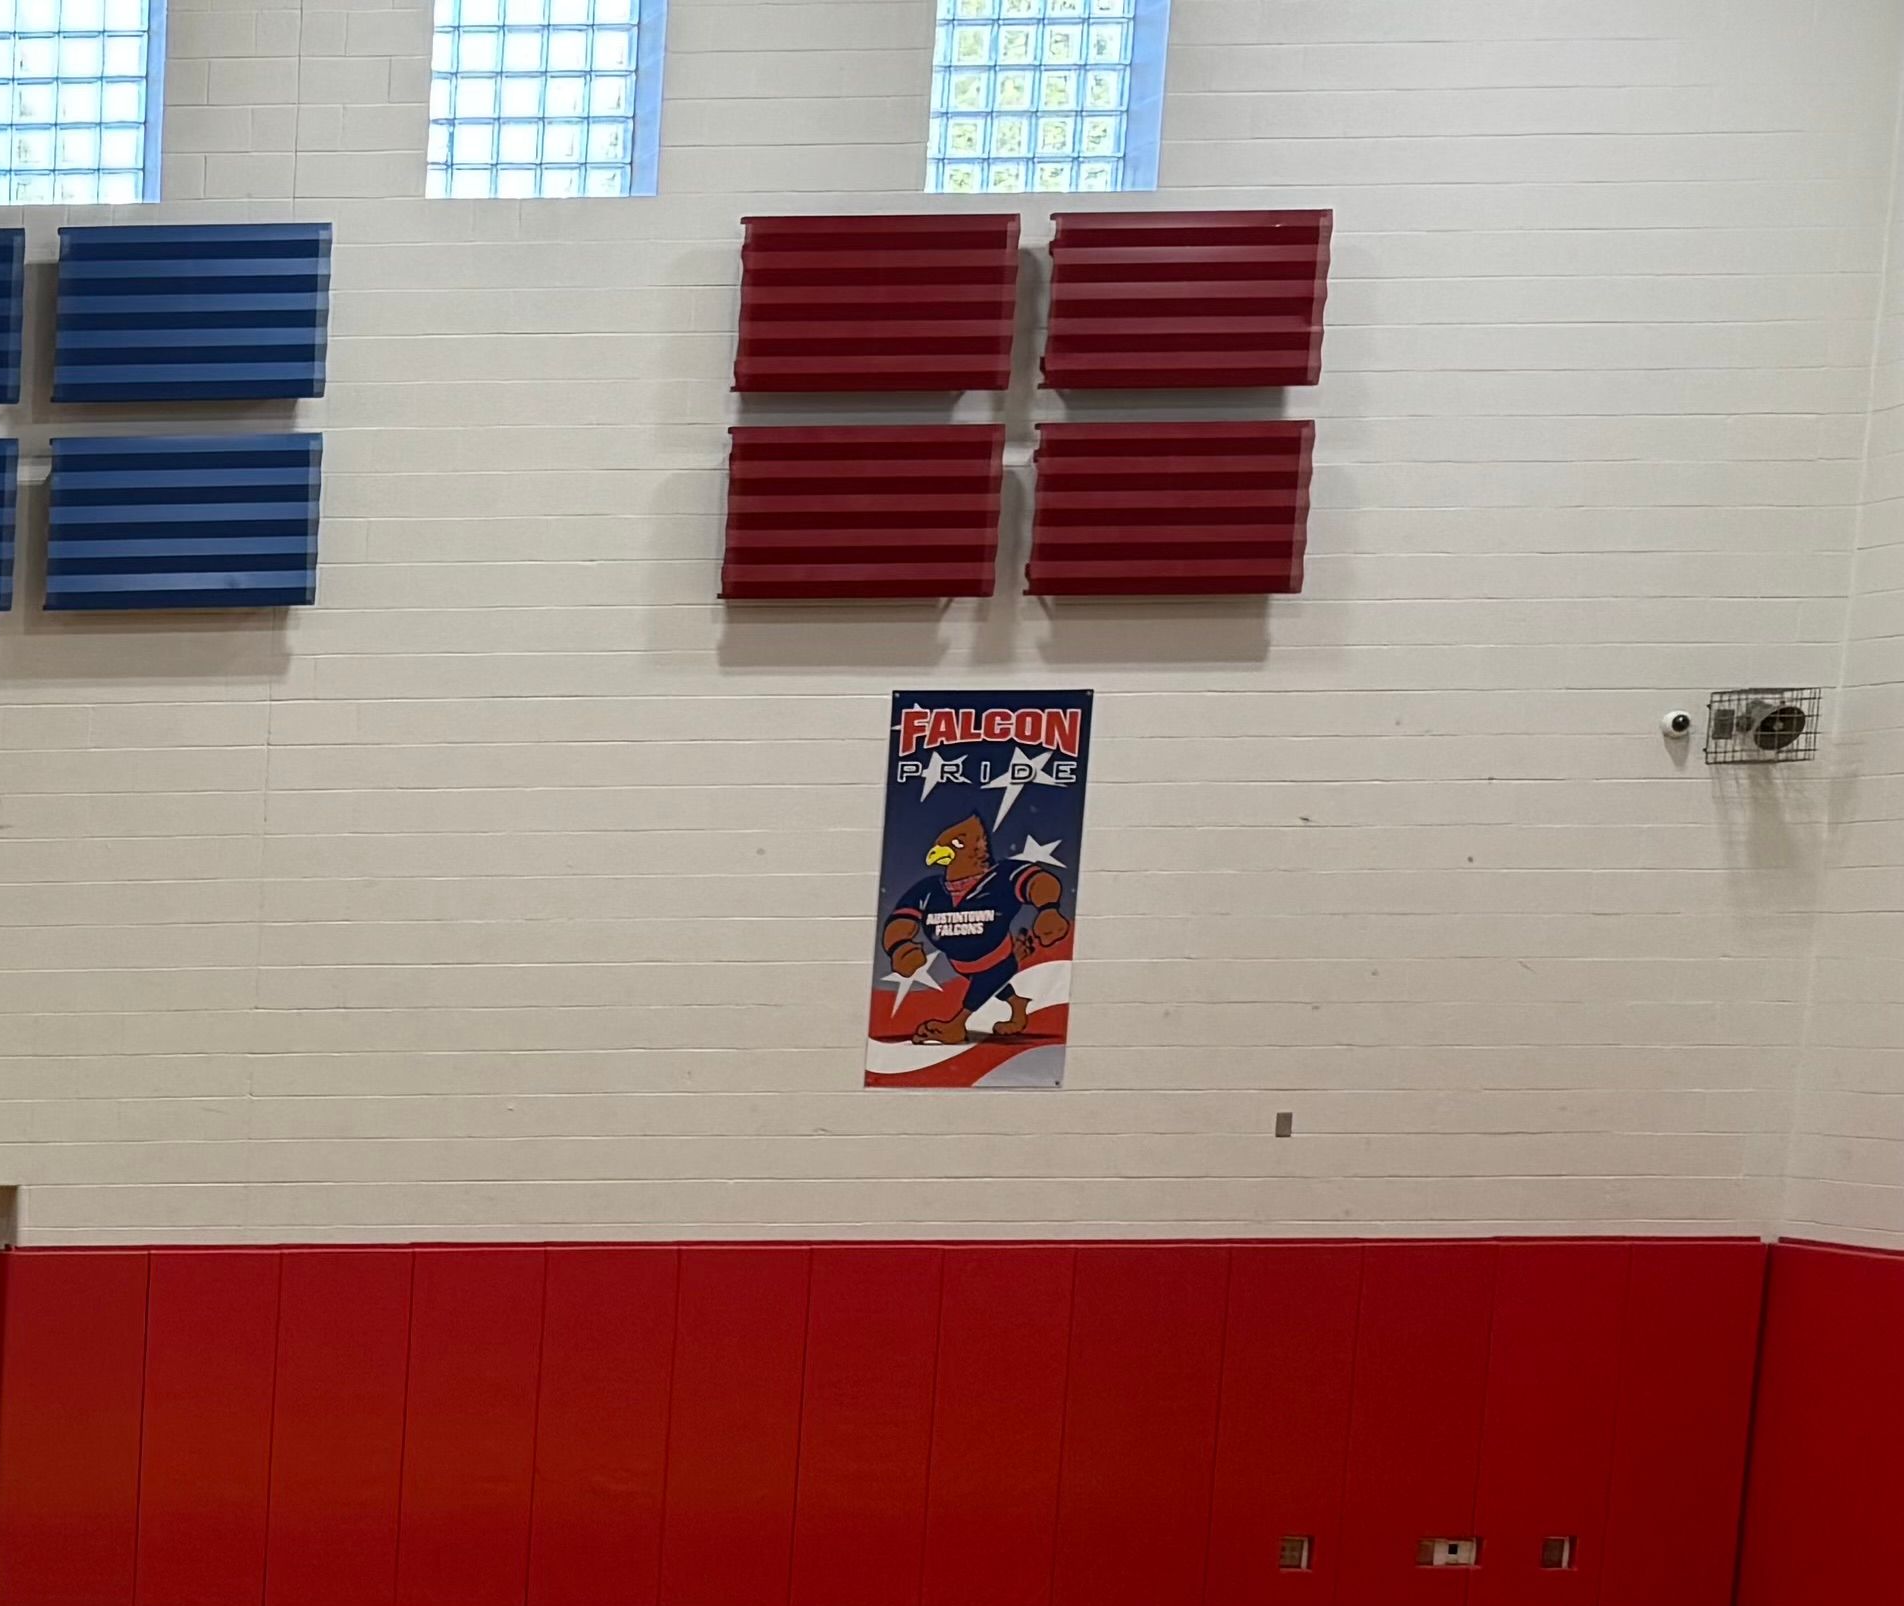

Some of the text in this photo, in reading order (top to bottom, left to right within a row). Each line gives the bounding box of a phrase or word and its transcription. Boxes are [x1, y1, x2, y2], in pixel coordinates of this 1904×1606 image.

[898, 708, 1082, 757] FALCON
[897, 761, 1077, 783] PRIDE
[935, 922, 984, 936] FALCONS
